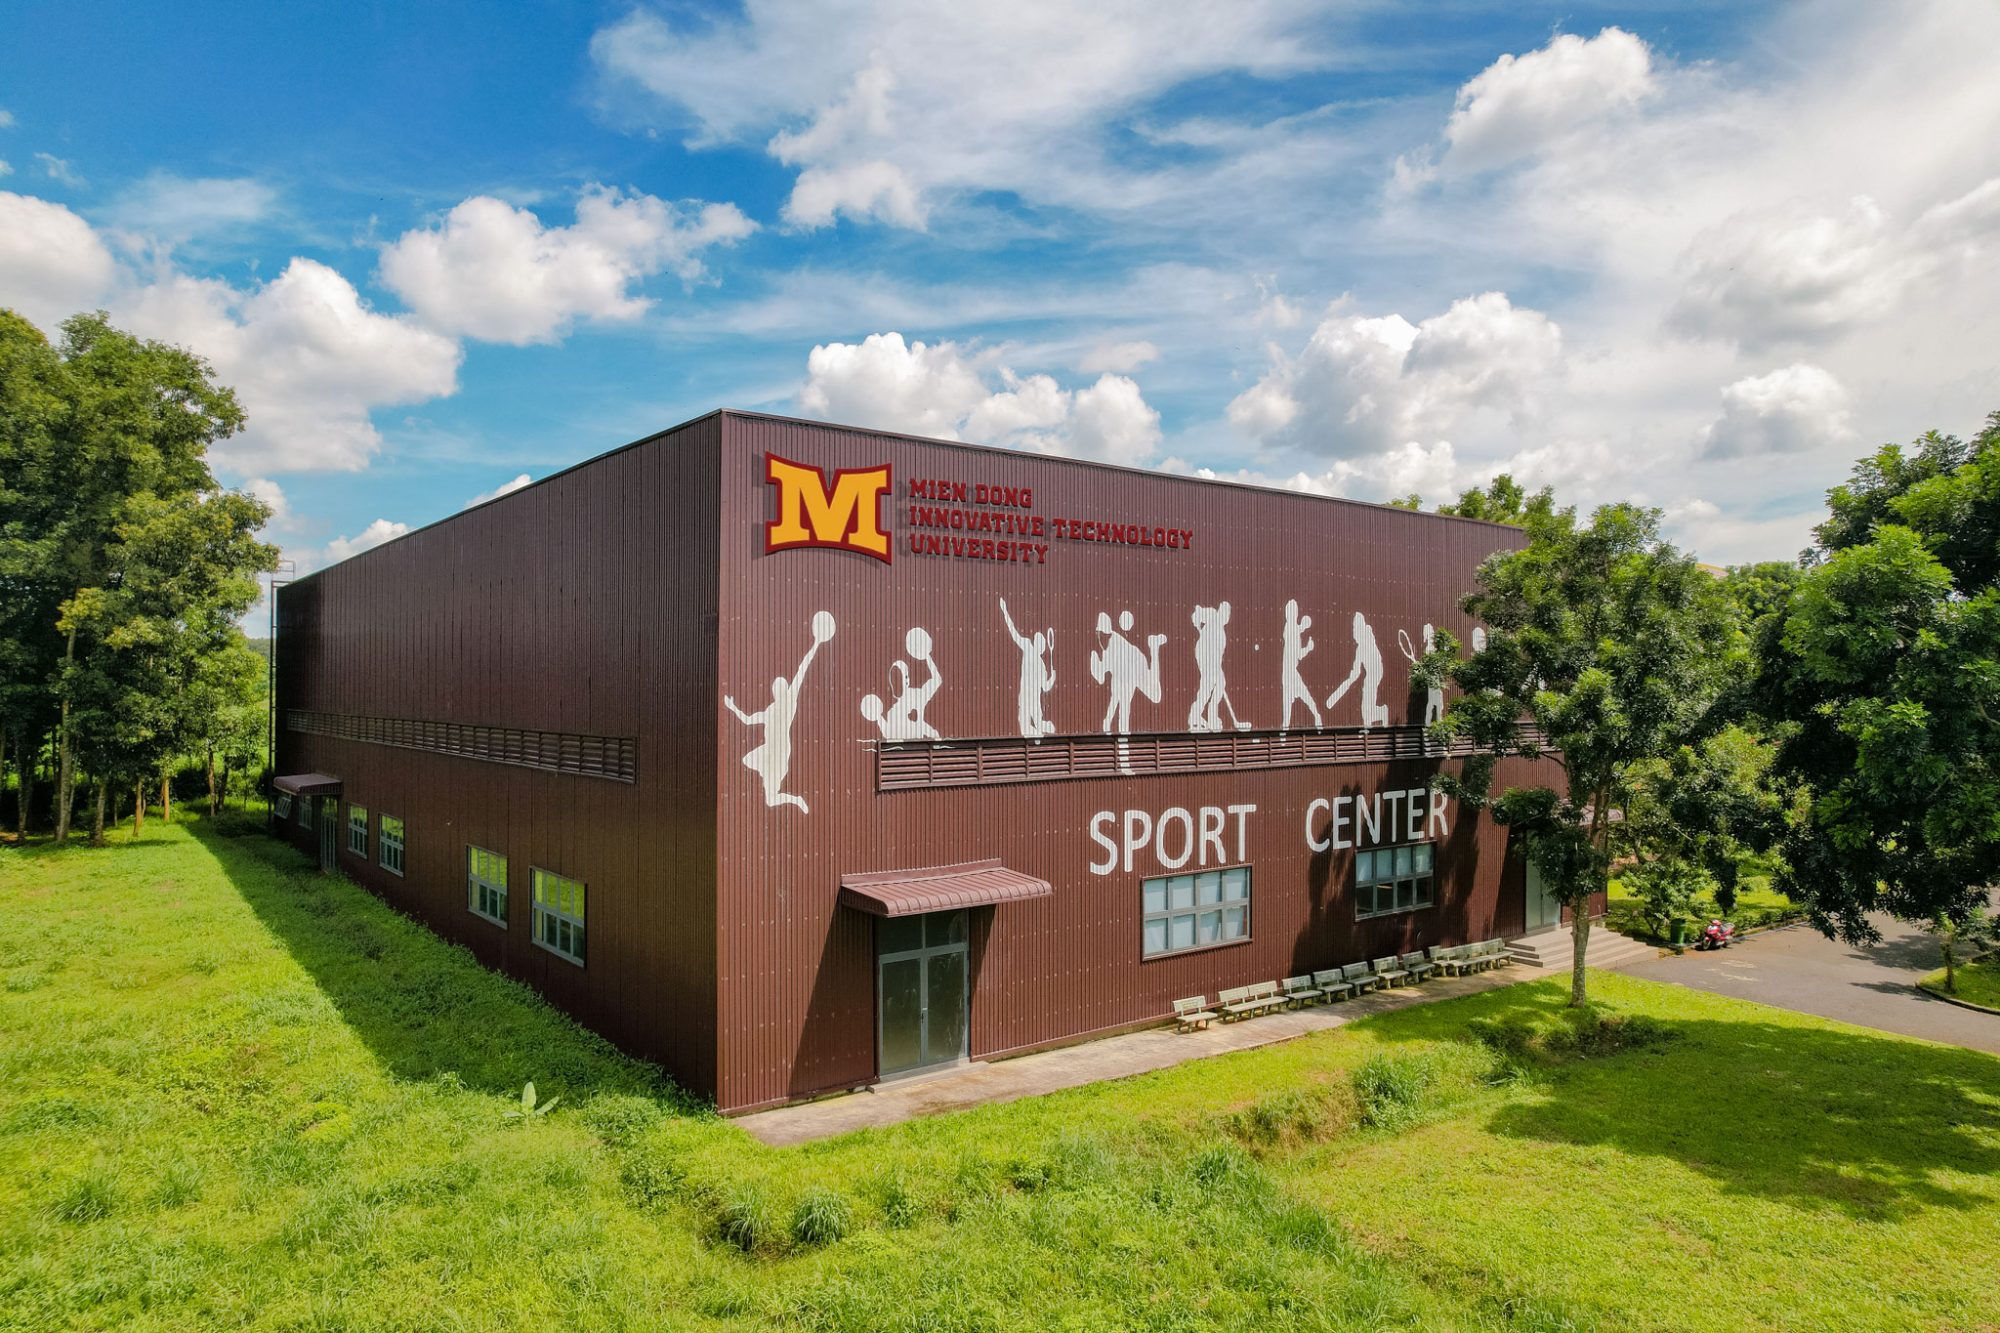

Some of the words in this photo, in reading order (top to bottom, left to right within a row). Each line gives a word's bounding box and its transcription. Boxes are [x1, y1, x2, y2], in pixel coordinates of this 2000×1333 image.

[765, 451, 892, 566] M
[909, 478, 966, 502] MIEN
[975, 484, 1032, 508] DONG
[909, 506, 1044, 537] INNOVATIVE
[1052, 518, 1193, 550] TECHNOLOGY
[910, 534, 1049, 564] UNIVERSITY
[1089, 804, 1257, 876] SPORT
[1306, 788, 1448, 852] CENTER
